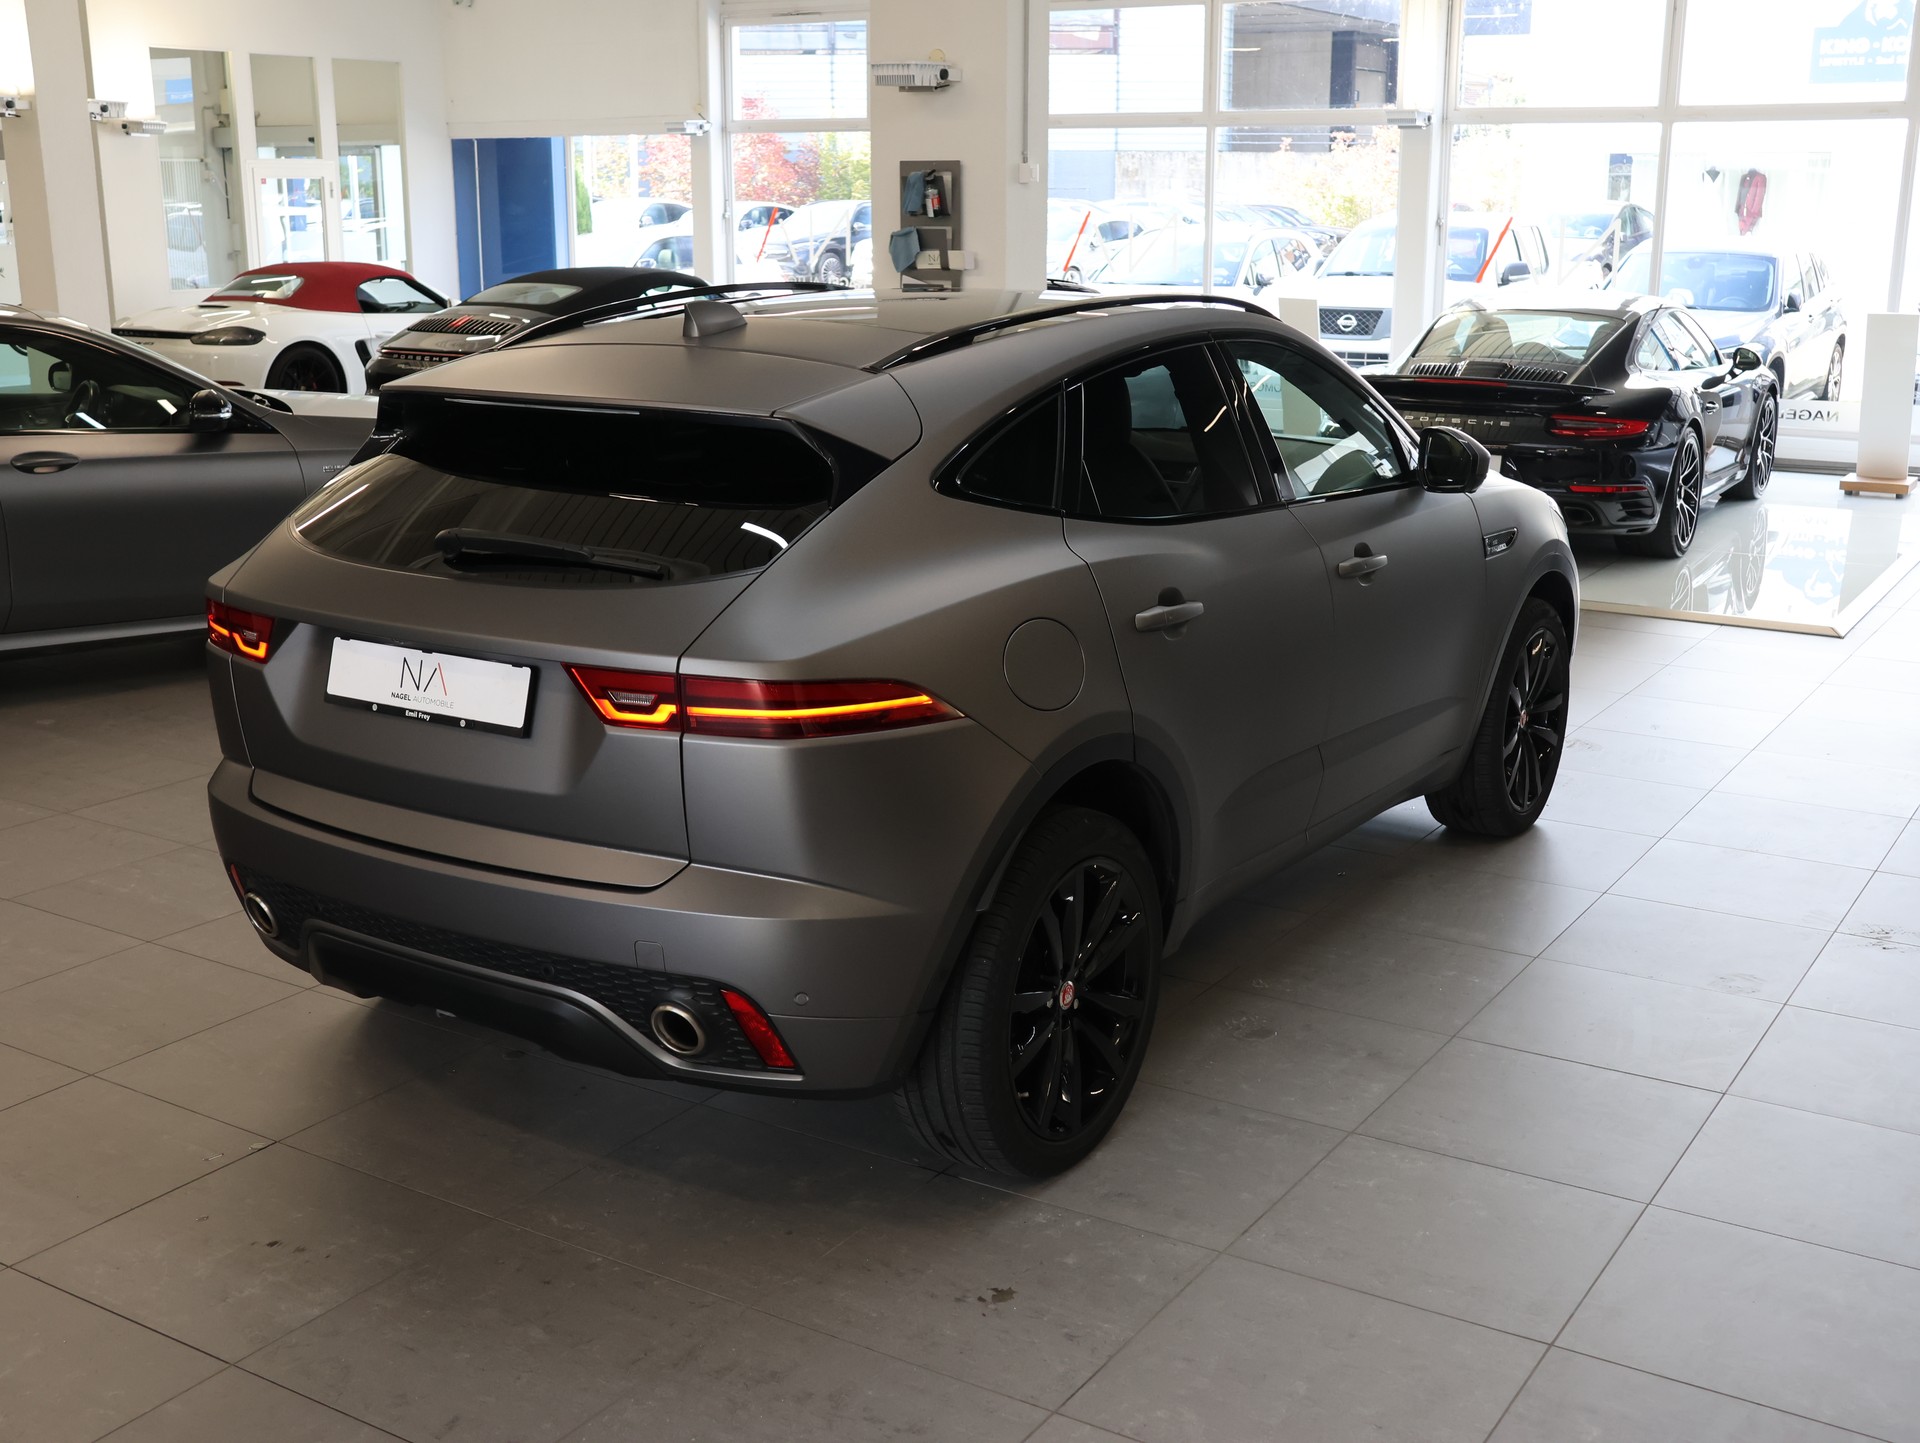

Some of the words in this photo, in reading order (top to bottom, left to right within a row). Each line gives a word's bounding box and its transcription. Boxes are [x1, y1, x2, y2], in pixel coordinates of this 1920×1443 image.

[393, 354, 449, 362] PORSCHE
[1404, 415, 1511, 427] PORSCHE
[391, 691, 411, 702] NAGEL
[412, 695, 454, 709] AUTOMOBILE
[405, 709, 418, 719] Emil
[418, 711, 431, 722] Frey
